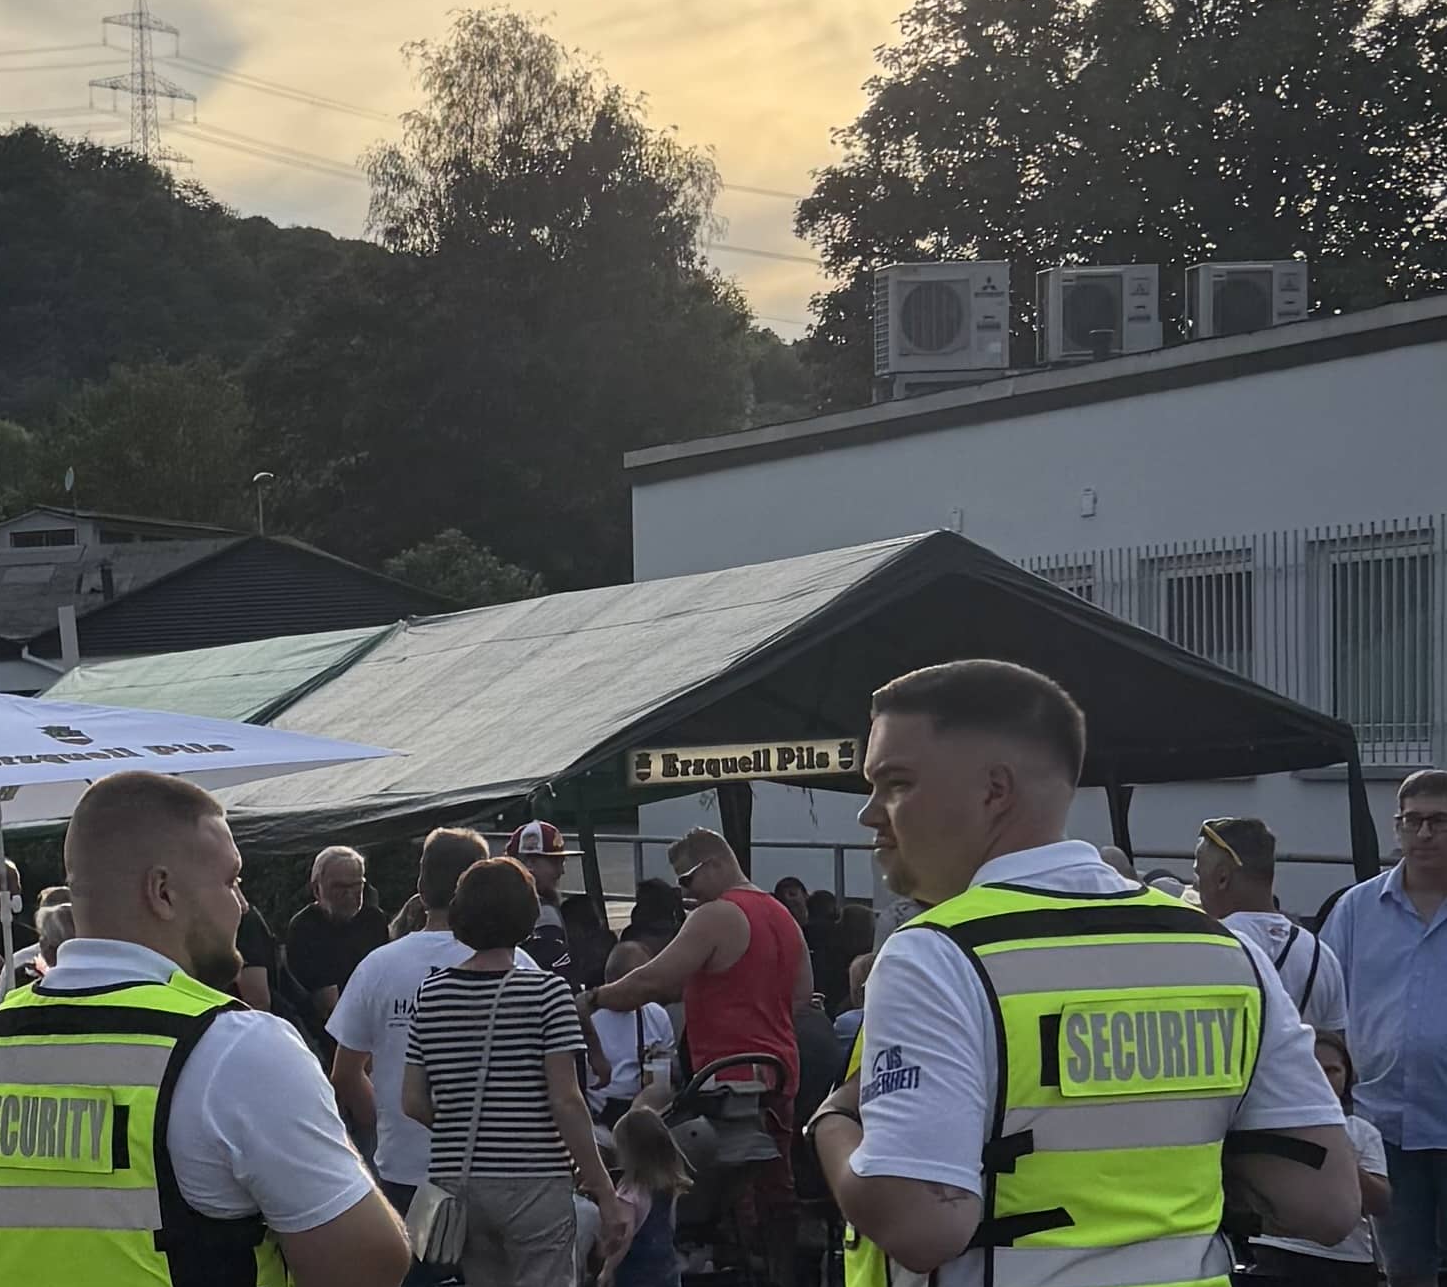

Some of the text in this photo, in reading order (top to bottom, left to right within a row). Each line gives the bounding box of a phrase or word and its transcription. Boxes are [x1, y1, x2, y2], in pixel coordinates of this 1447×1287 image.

[661, 746, 830, 778] Erzquell Pils
[1066, 1007, 1239, 1083] SECURITY
